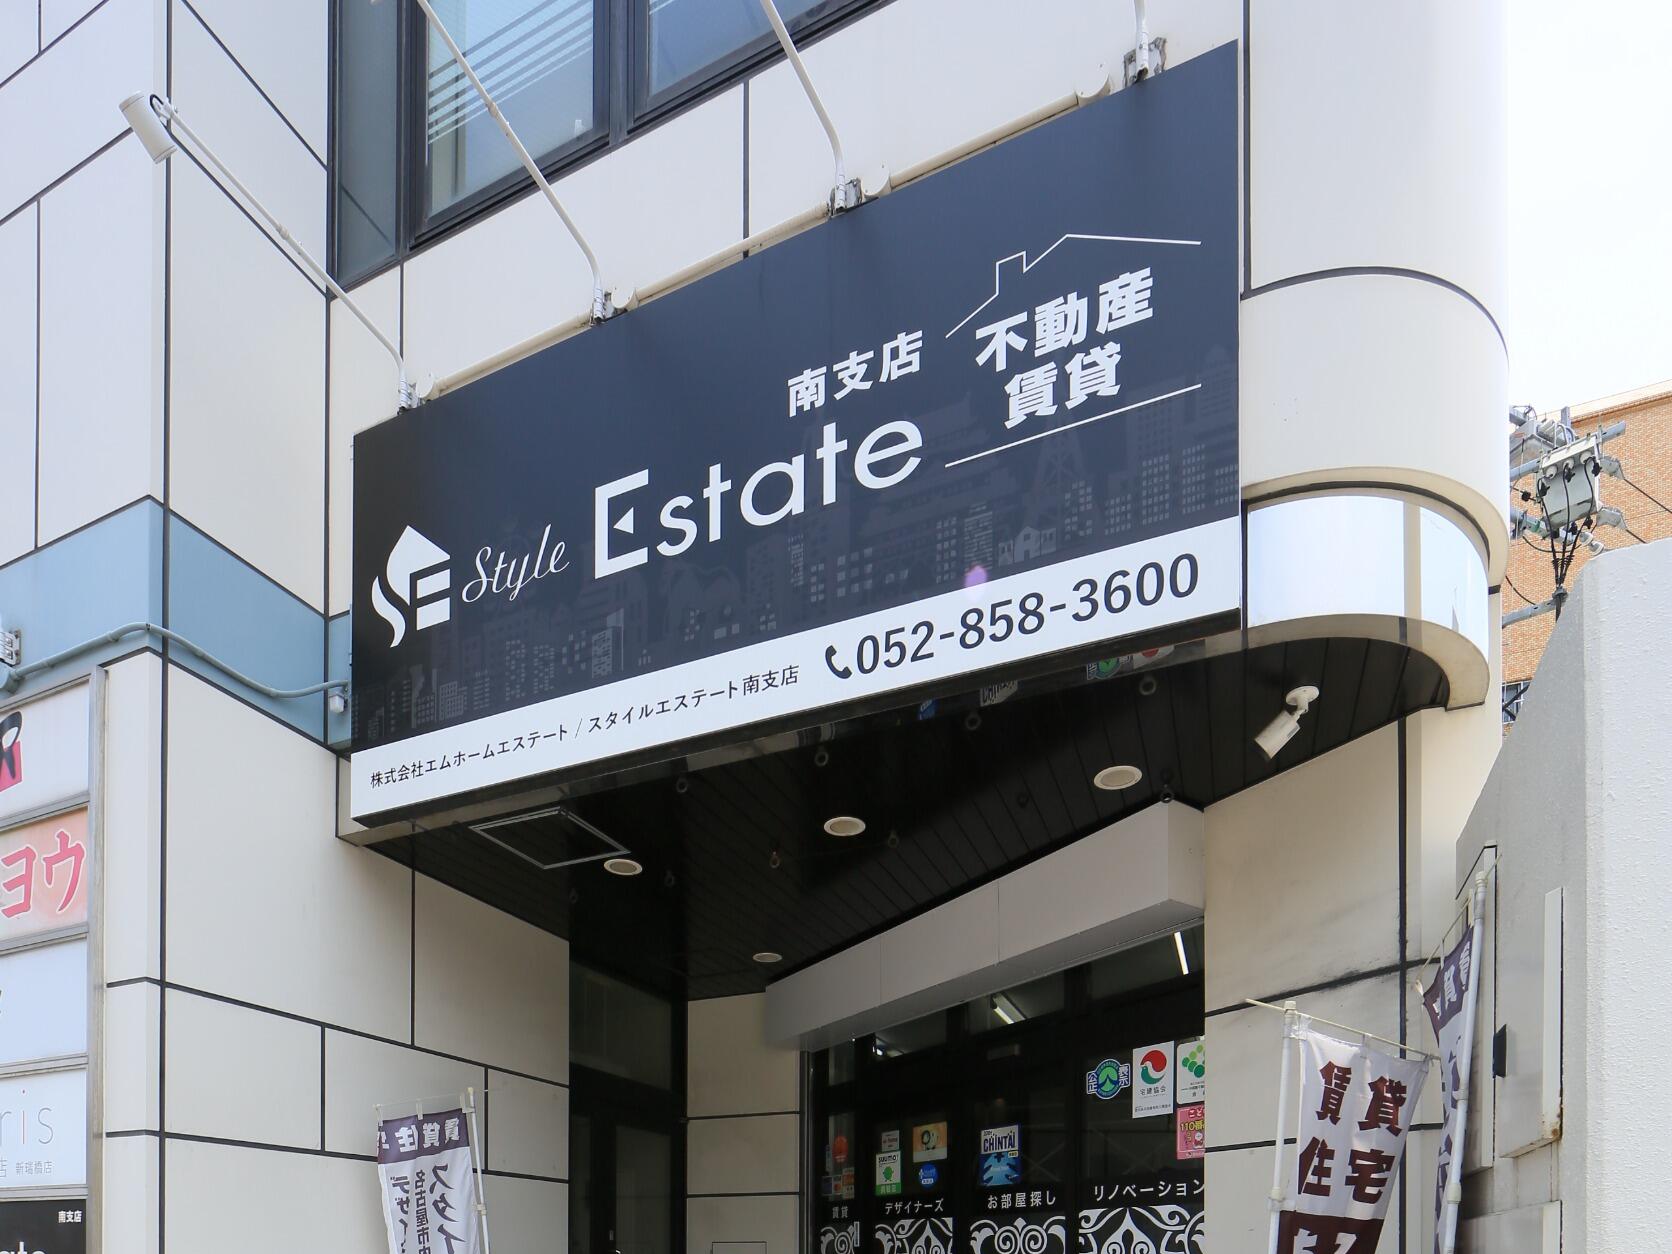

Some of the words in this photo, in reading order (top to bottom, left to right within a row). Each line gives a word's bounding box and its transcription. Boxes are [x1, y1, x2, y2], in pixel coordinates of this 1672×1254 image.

[975, 267, 1153, 373] 不動産
[787, 330, 923, 418] 南支店
[1004, 341, 1121, 430] 賃貸
[461, 523, 569, 603] Style
[594, 420, 923, 580] Estate
[856, 552, 1200, 676] 052-858-3600
[370, 724, 568, 789] 株式会社エムホームエステート
[588, 664, 800, 734] スタイルエステート南支店
[1316, 1060, 1407, 1137] 賃貸
[15, 1161, 53, 1176] 新瑞橋店
[983, 1136, 1015, 1153] CHINTAI
[1299, 1136, 1395, 1205] 住宅
[58, 1211, 82, 1223] 南支店
[832, 1206, 849, 1219] 賃貸
[885, 1199, 944, 1215] デザイナーズ
[987, 1192, 1057, 1210] お部屋探し
[1094, 1179, 1205, 1202] リノベーション
